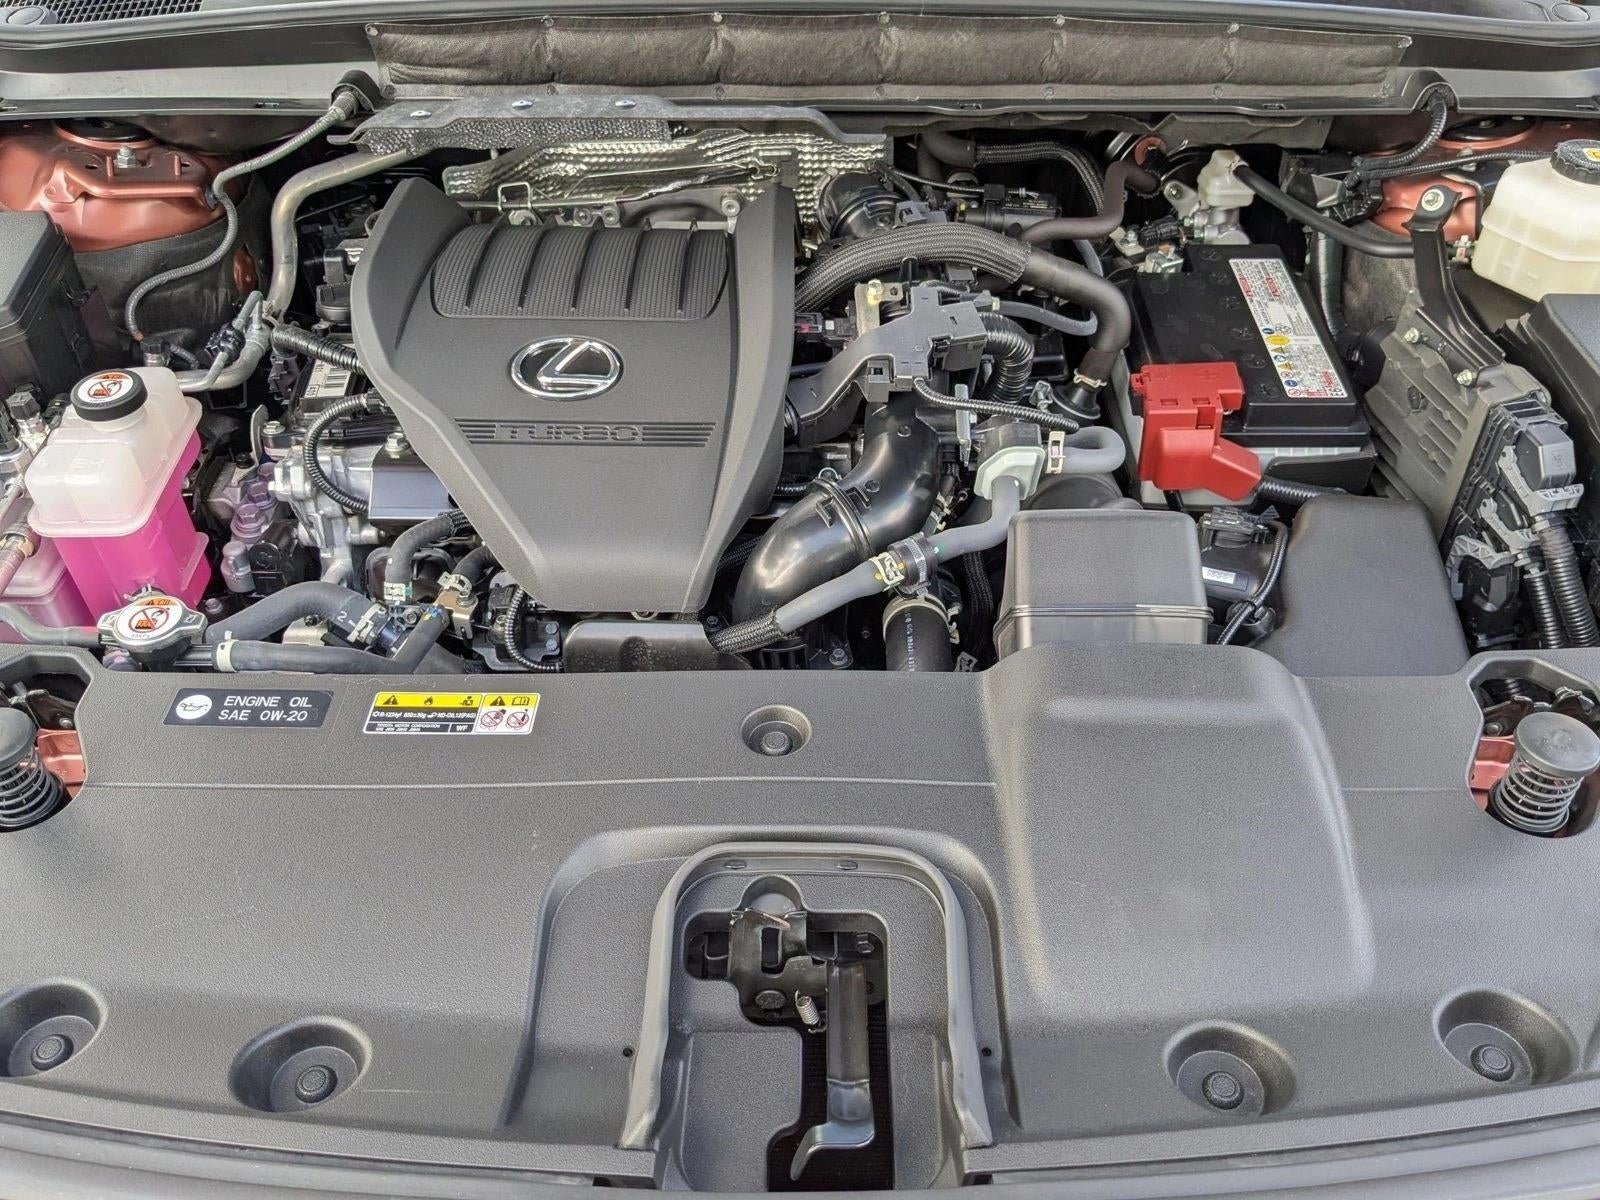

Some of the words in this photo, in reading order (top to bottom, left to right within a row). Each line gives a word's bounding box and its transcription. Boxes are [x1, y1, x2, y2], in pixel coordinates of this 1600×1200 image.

[499, 424, 640, 442] TURBO
[337, 610, 348, 622] 2
[224, 695, 281, 707] ENGINE
[289, 696, 312, 708] OIL
[218, 708, 251, 721] SAE
[260, 709, 308, 722] 0W-20
